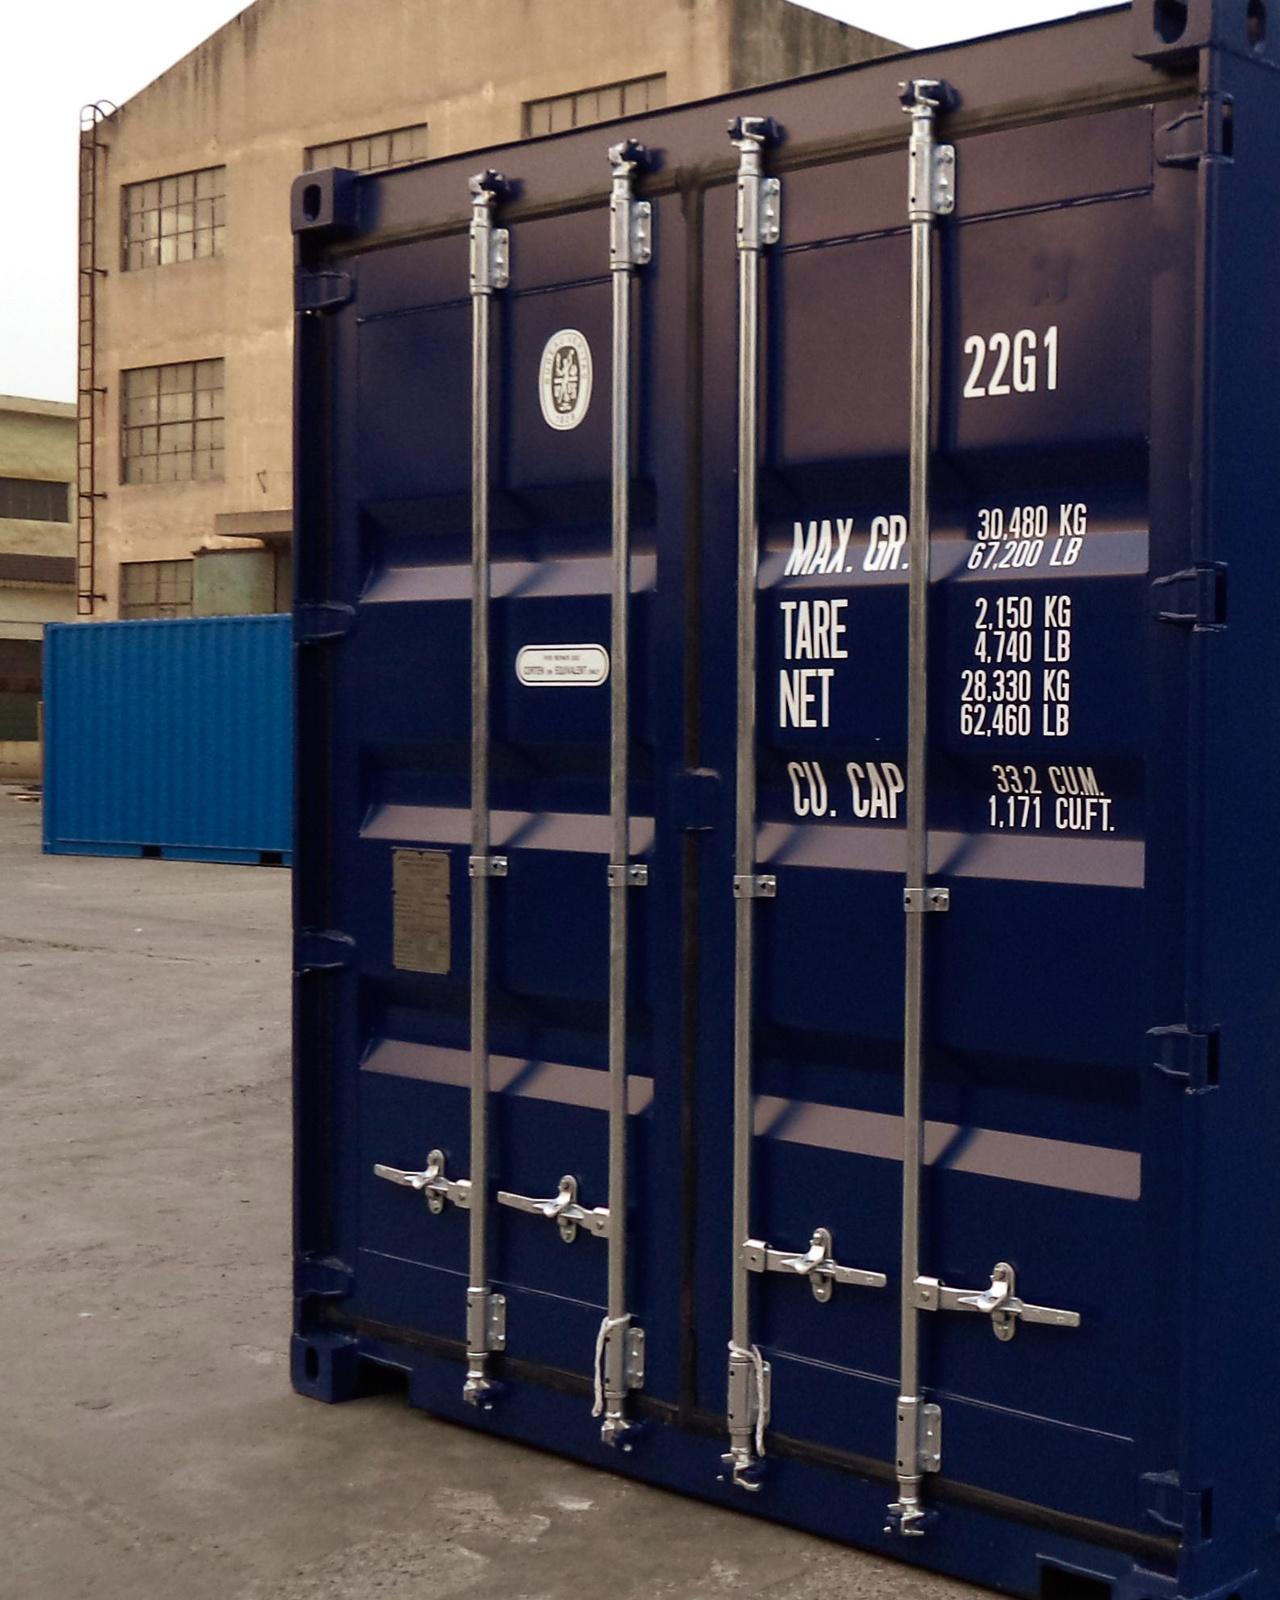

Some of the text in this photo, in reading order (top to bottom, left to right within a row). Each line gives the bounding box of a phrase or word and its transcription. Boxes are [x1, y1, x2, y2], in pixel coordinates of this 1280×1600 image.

[963, 325, 1059, 398] 22G1
[977, 503, 1087, 541] 30,480 KG
[784, 514, 909, 577] MAX. GR.
[967, 537, 1081, 570] 67,200 LB
[780, 599, 848, 659] TARE
[975, 595, 1071, 630] 2,150 KG
[974, 630, 1070, 663] 4,740 LB
[779, 669, 834, 728] NET
[960, 669, 1070, 702] 28,330 KG
[959, 704, 1070, 738] 62,460 LB
[788, 761, 905, 819] CU. CAP
[991, 764, 1041, 794] 33.2
[989, 796, 1041, 829] 1,171
